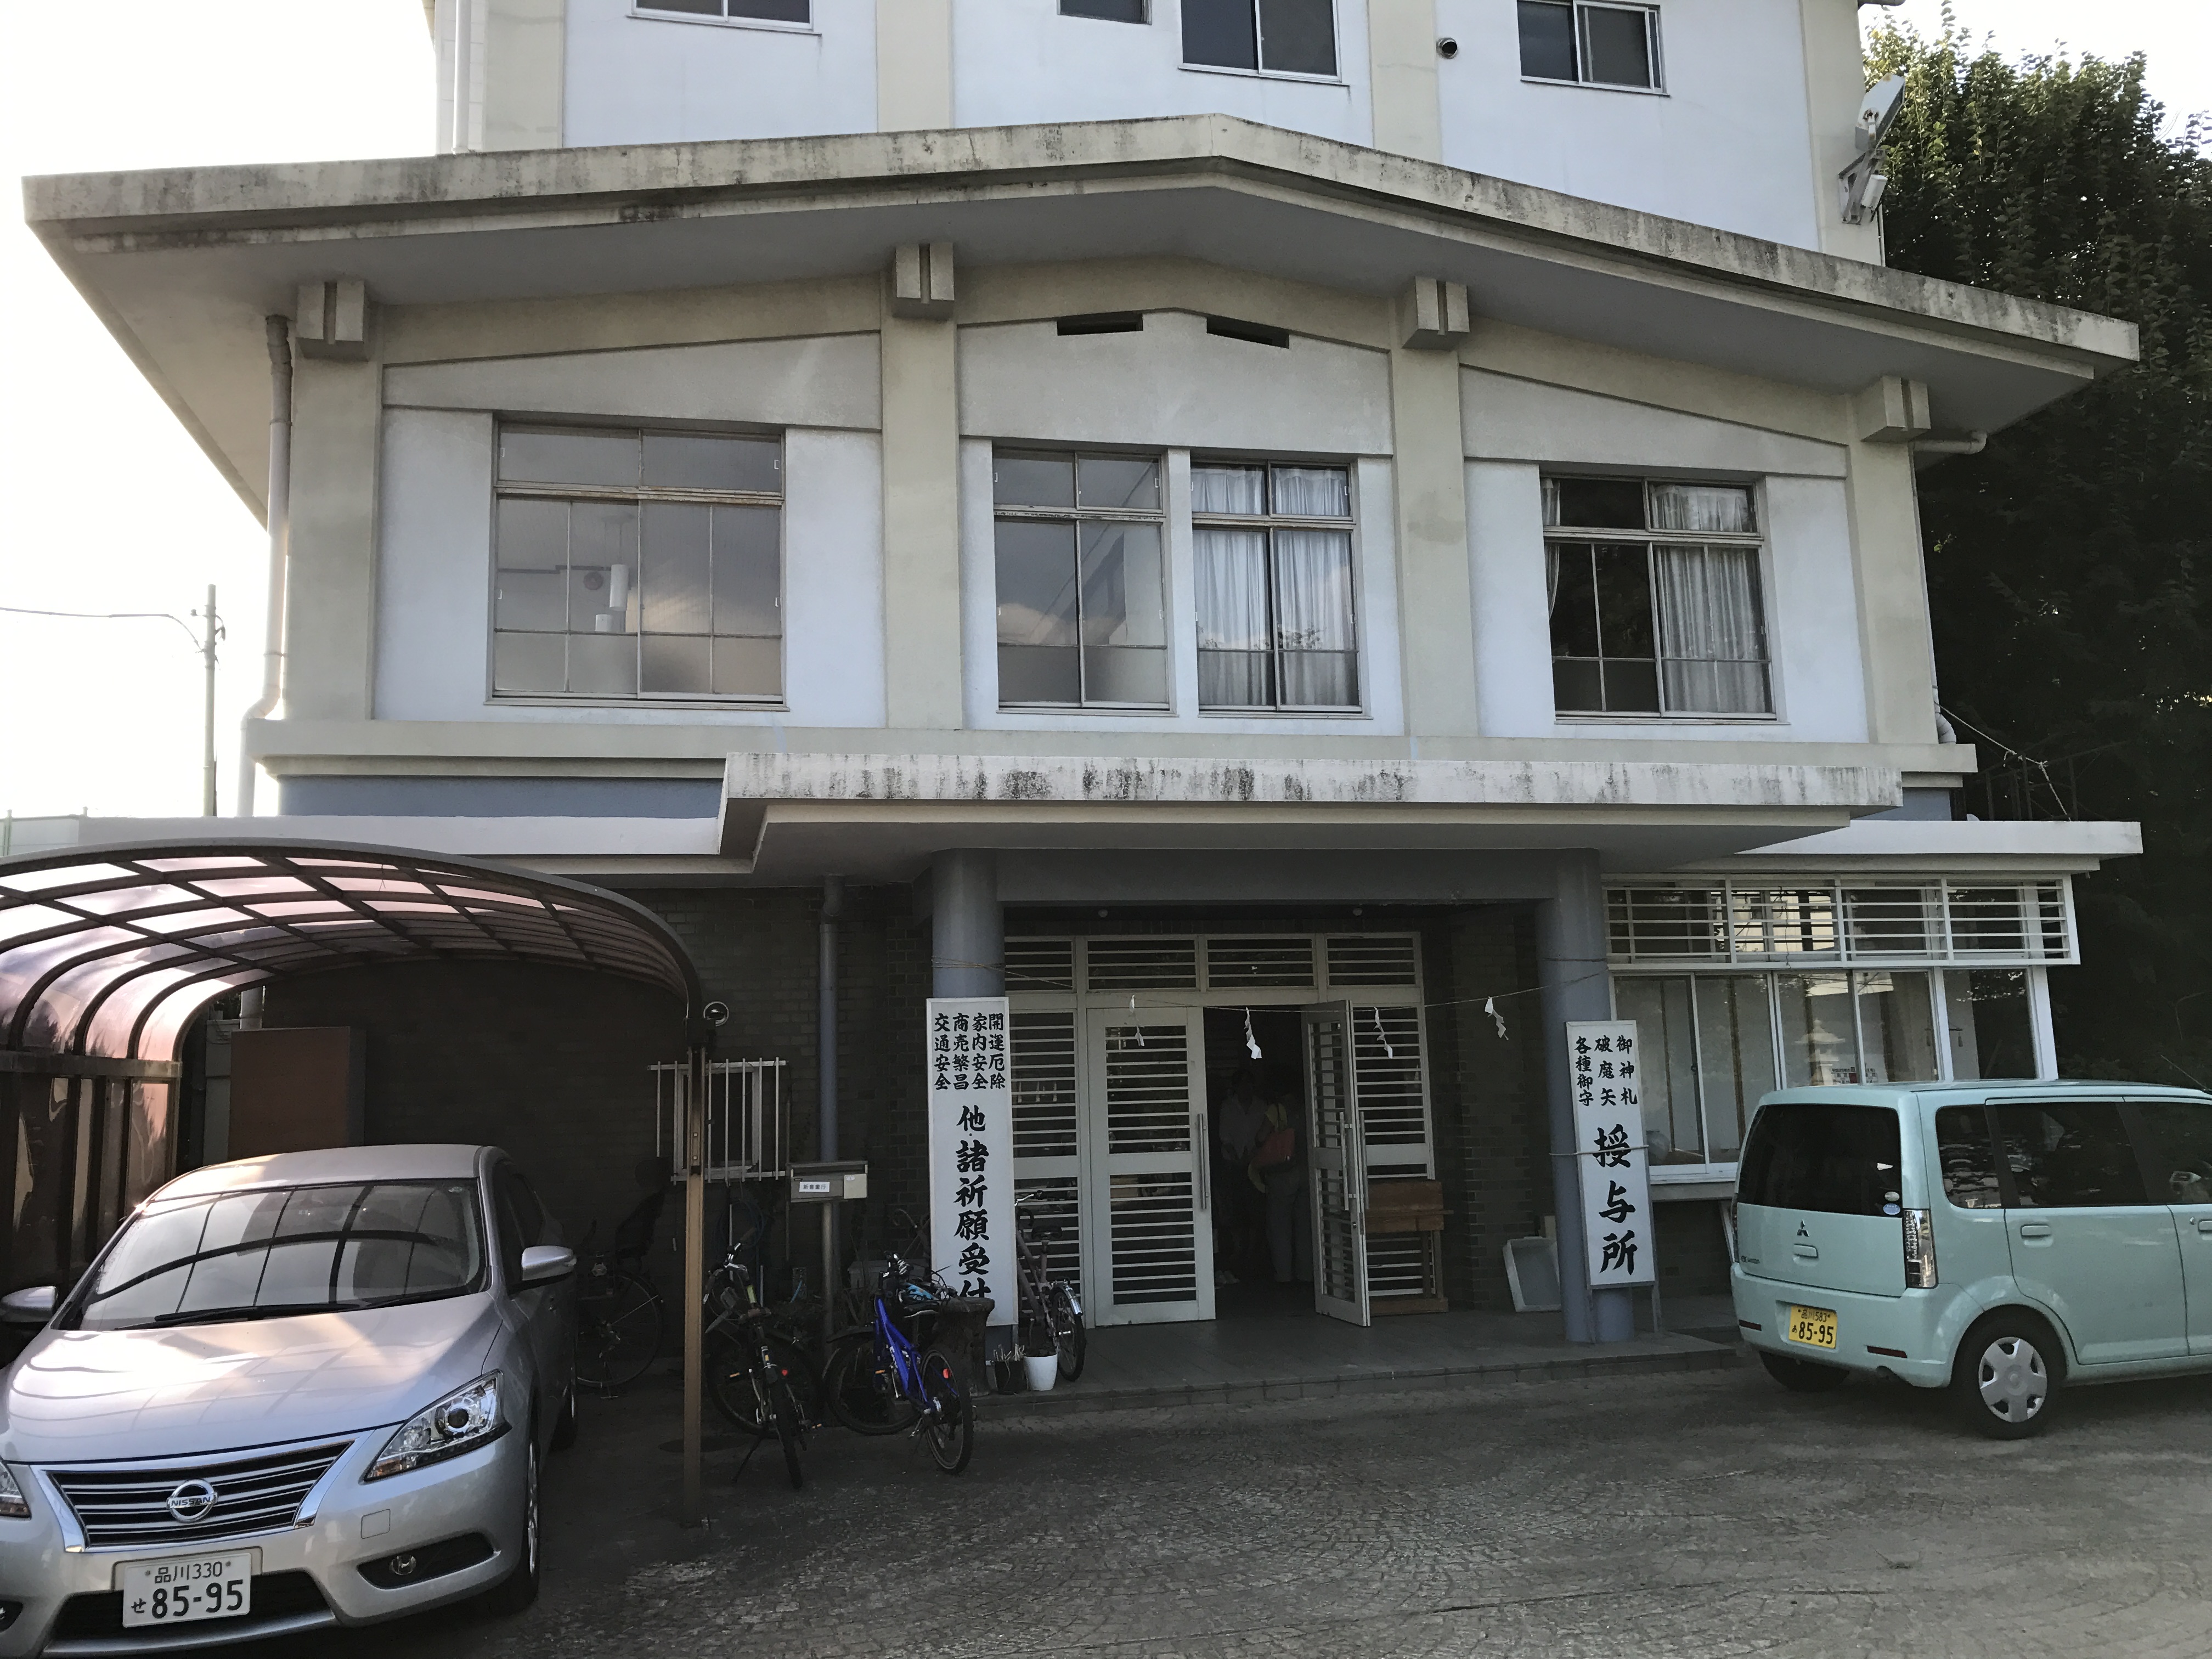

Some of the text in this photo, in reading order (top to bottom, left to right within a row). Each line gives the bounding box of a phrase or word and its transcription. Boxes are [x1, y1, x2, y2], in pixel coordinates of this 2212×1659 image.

[934, 1013, 951, 1090] 交通安全
[952, 1013, 969, 1090] 商売繁昌
[972, 1013, 988, 1090] 家内安全
[989, 1013, 1006, 1090] 開運厄除
[1575, 1036, 1594, 1107] 各種御守
[1594, 1035, 1616, 1106] 破魔矢
[1616, 1035, 1638, 1105] 御神札
[1593, 1124, 1638, 1276] 授与所
[1799, 1322, 1834, 1344] 85-95
[171, 1496, 211, 1506] NISSAN
[131, 1579, 243, 1618] せ 85-95
